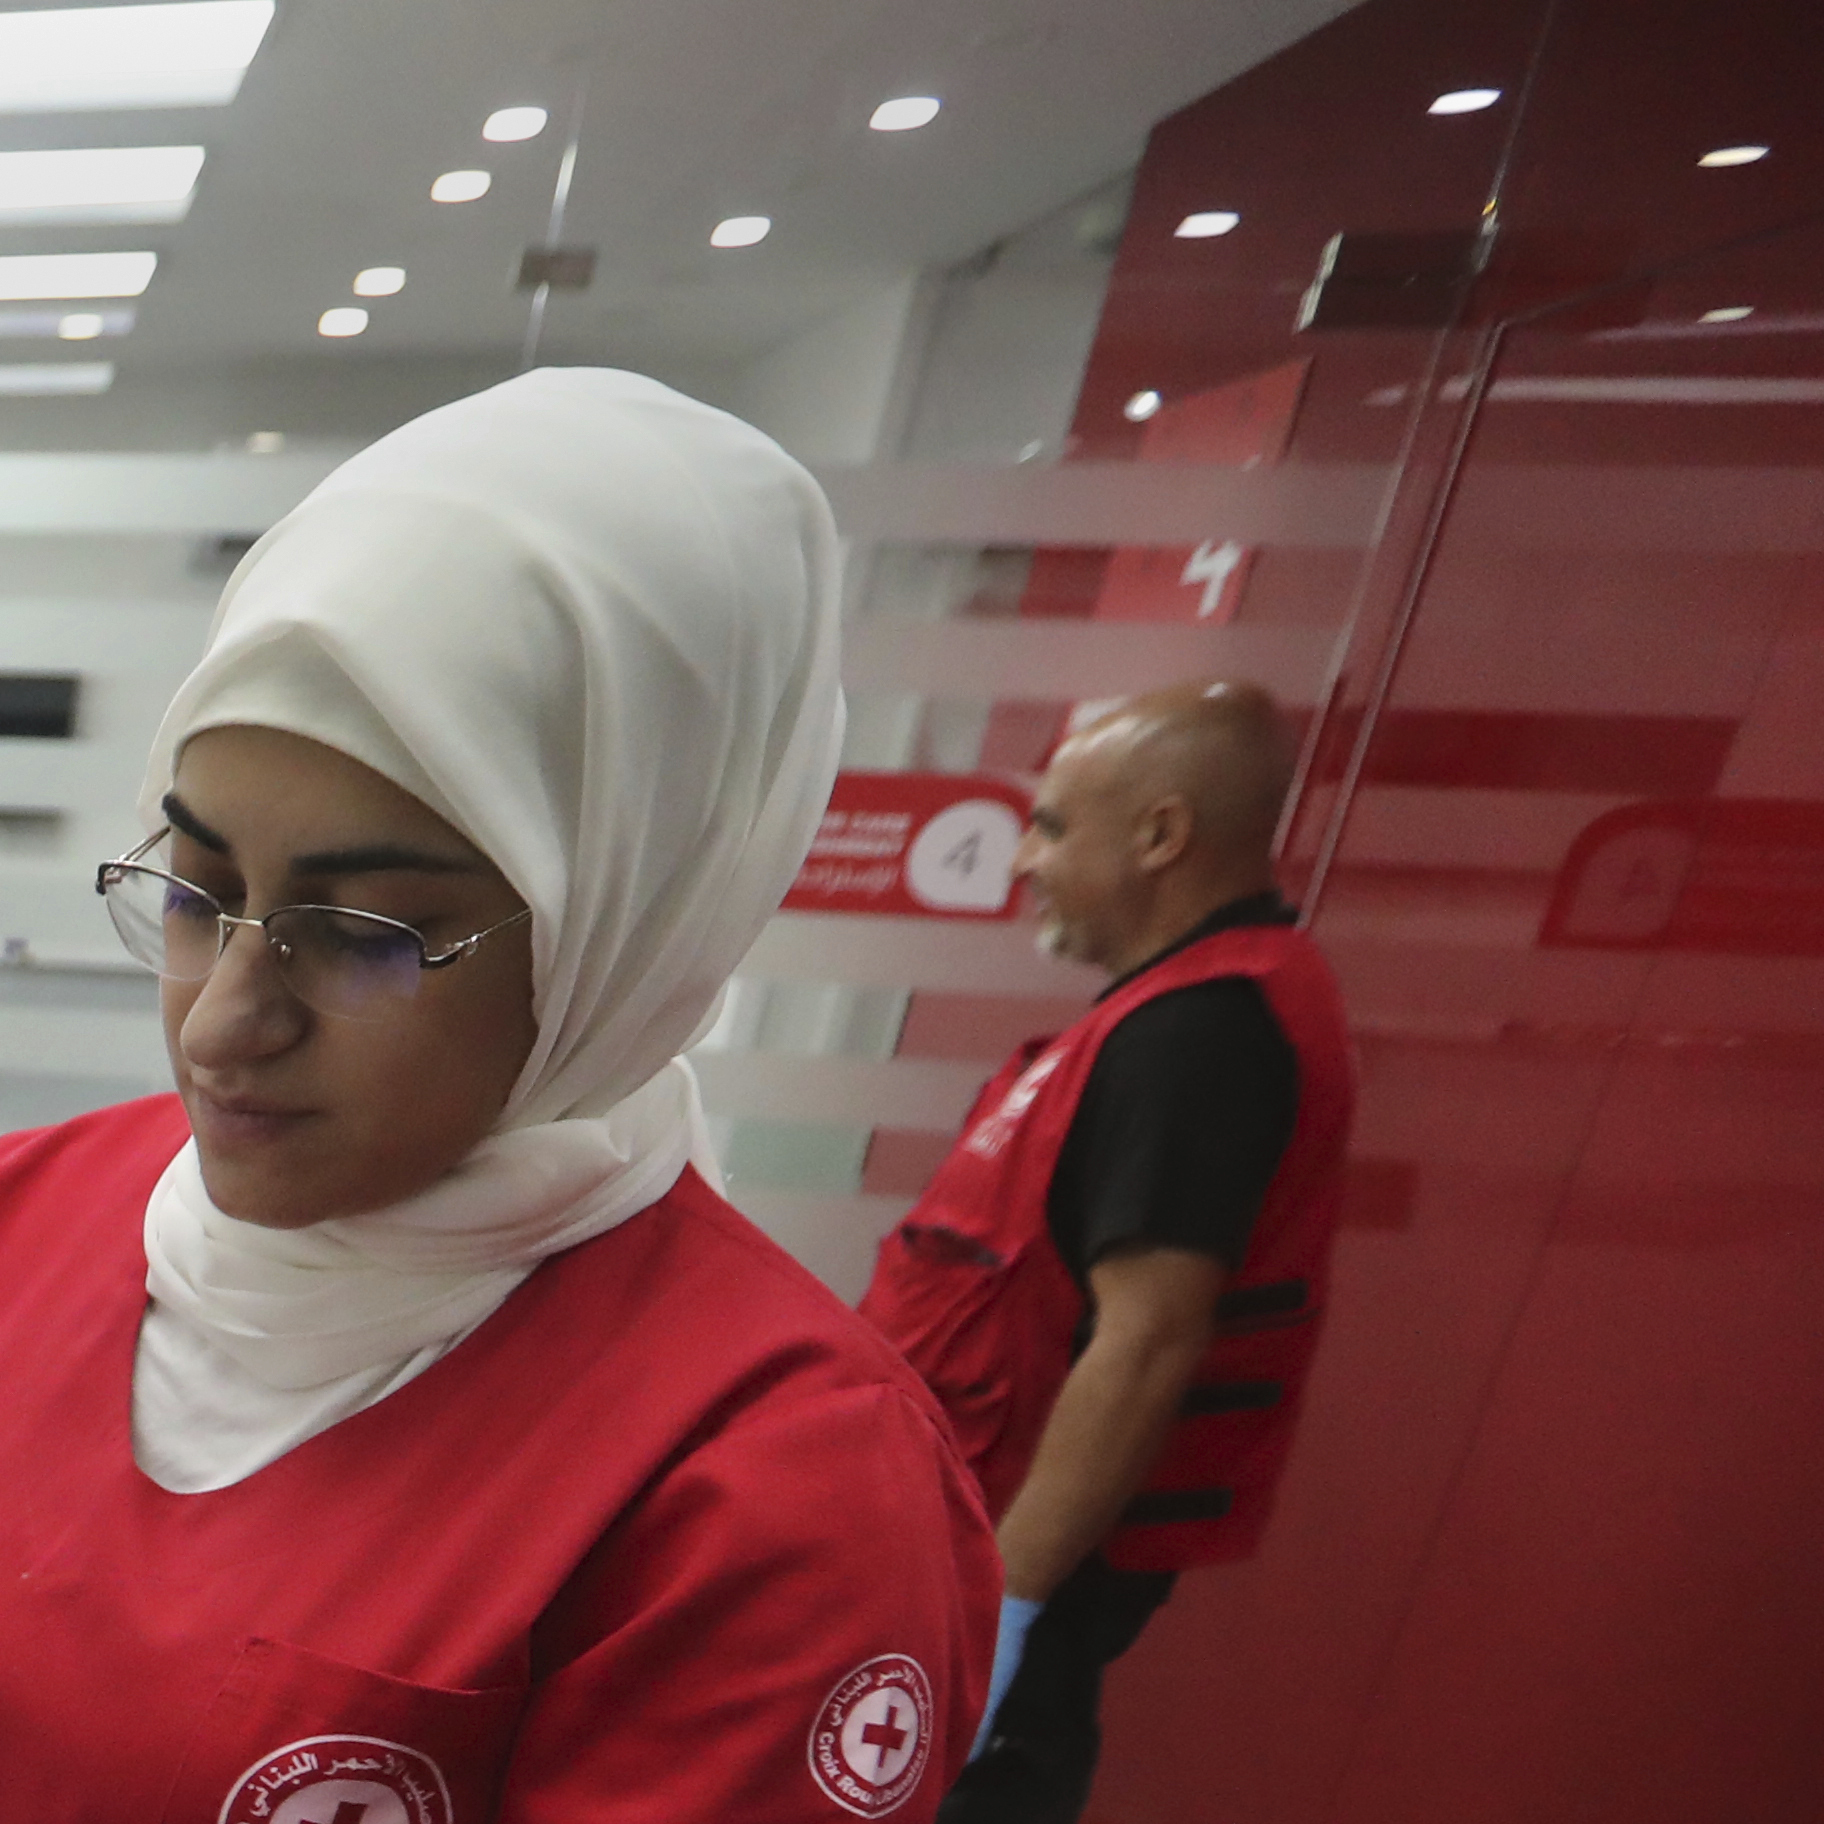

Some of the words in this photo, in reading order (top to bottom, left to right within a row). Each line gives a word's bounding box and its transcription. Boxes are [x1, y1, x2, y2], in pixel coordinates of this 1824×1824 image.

[247, 1752, 319, 1817] اللبناني
[818, 1731, 841, 1779] Croix
[836, 1774, 873, 1804] Rou
